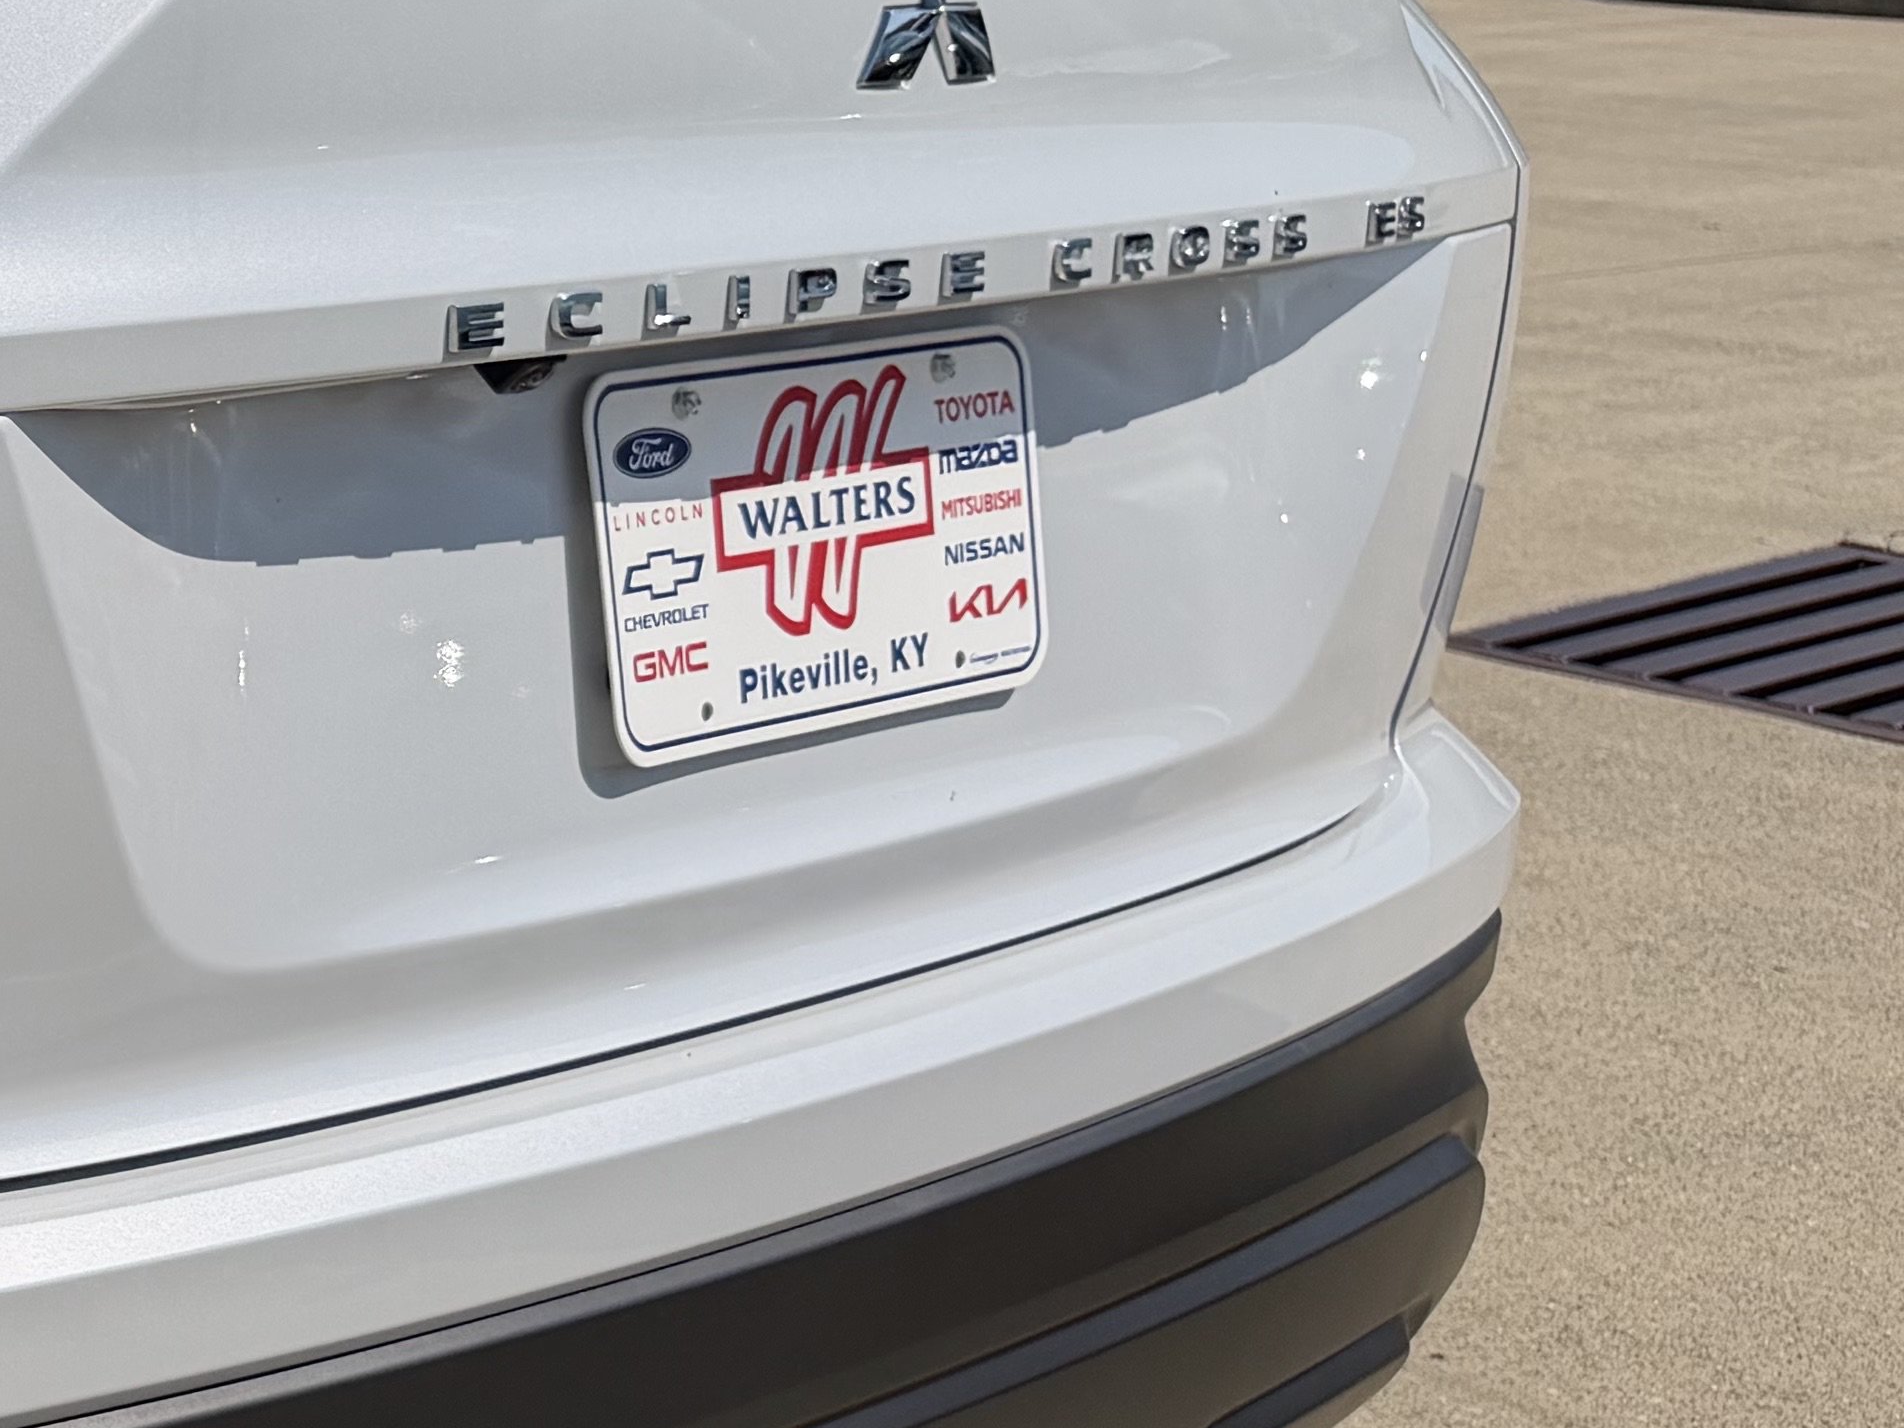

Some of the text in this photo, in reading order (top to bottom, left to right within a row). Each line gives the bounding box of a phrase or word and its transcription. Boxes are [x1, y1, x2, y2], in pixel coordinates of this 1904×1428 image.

[448, 196, 1424, 352] ECLIPSE CROSS ES
[934, 390, 1015, 423] TOYOTA
[629, 437, 674, 471] Ford
[613, 502, 704, 532] LINCOLN
[738, 477, 916, 540] WALTERS
[941, 488, 1022, 521] MITSUBISHI
[944, 532, 1026, 566] NISSAN
[624, 604, 709, 632] CHEVROLET
[633, 641, 709, 683] GMC
[740, 650, 879, 704] Pikeville,
[891, 633, 930, 673] KY
